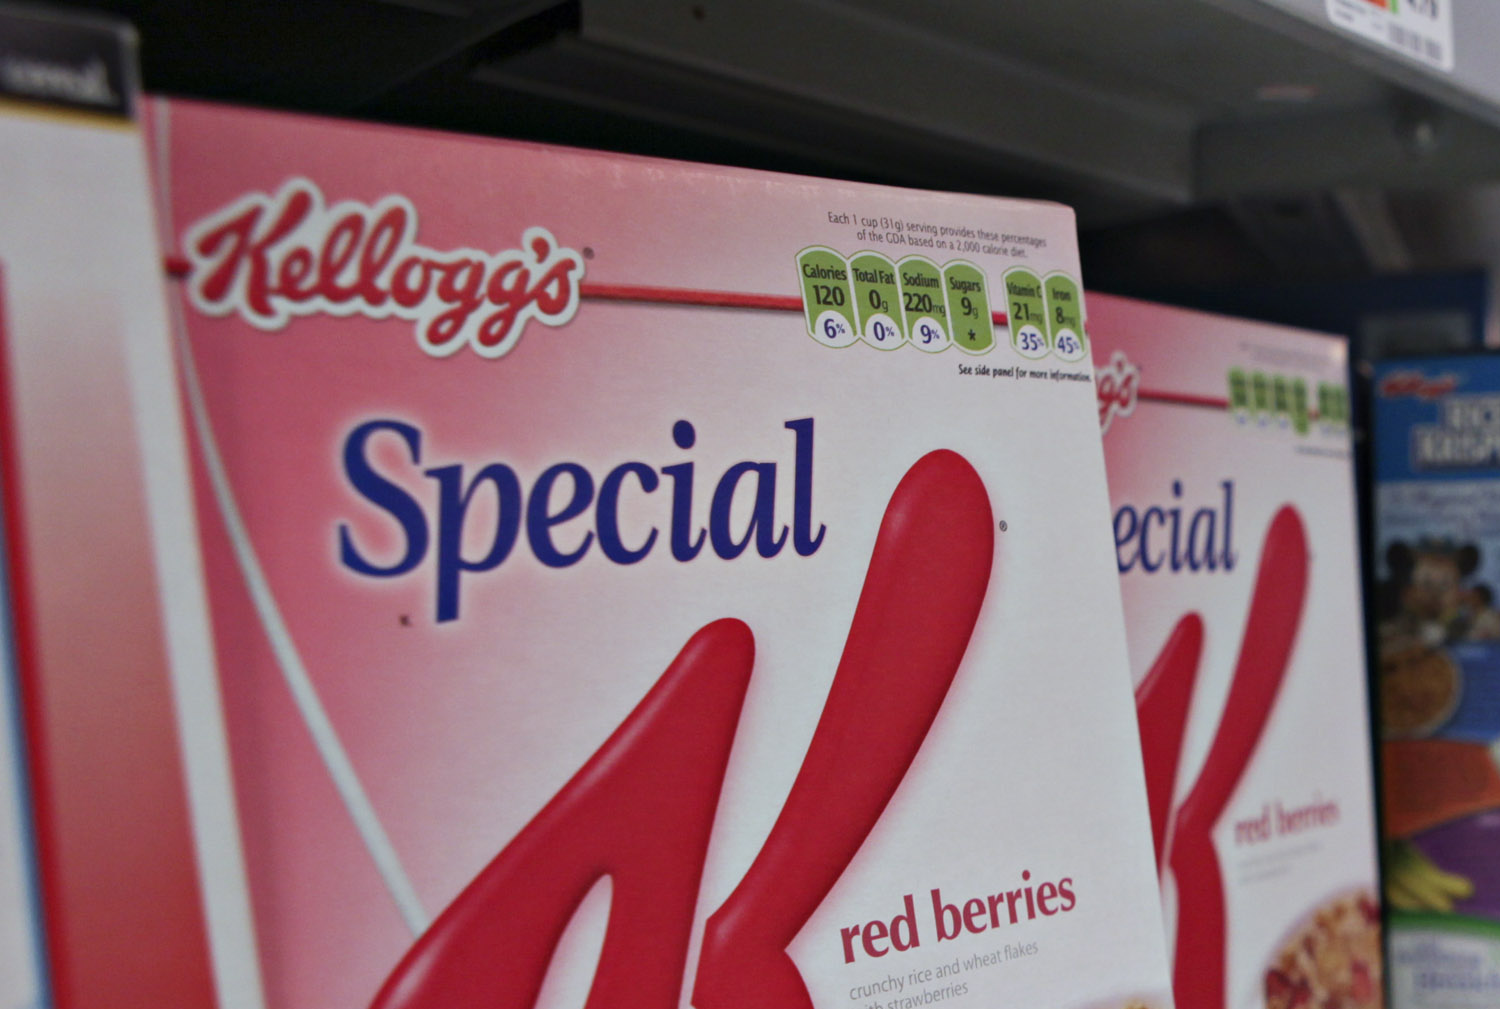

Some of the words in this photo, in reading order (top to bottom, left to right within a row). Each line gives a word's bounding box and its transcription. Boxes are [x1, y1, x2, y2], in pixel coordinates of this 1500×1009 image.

[828, 212, 850, 224] Each
[853, 214, 858, 225] 1
[861, 217, 878, 228] cup
[880, 217, 904, 232] (31g)
[906, 222, 938, 236] serving
[940, 226, 976, 239] provides
[977, 229, 999, 241] these
[1001, 233, 1047, 249] percentages
[857, 230, 866, 240] of
[869, 231, 883, 242] the
[908, 236, 934, 248] based
[936, 240, 947, 249] on
[949, 242, 954, 250] a
[956, 240, 980, 253] 2,000
[982, 244, 1009, 257] calorie
[194, 188, 577, 348] Kellogg's
[803, 264, 848, 282] Calories
[853, 268, 879, 283] Total
[879, 271, 896, 286] Fat
[903, 272, 940, 289] Sodium
[950, 276, 982, 293] Sugars
[1006, 282, 1036, 297] Vitamin
[813, 285, 845, 307] 120
[869, 289, 889, 313] 0g
[904, 292, 946, 318] 220mg
[1052, 288, 1071, 302] Iron
[961, 296, 979, 320] 9g
[1012, 302, 1043, 325] 21mg
[824, 318, 846, 340] 6%
[873, 321, 895, 342] 0%
[920, 324, 940, 345] 9%
[958, 363, 974, 376] See
[974, 365, 991, 377] side
[992, 367, 1015, 379] panel
[1015, 366, 1028, 381] for
[1028, 370, 1048, 380] more
[338, 416, 828, 624] Special
[1113, 479, 1236, 574] ecial
[840, 893, 921, 964] red
[930, 869, 1077, 944] berries
[849, 974, 905, 1001] crunchy
[908, 968, 933, 986] rice
[935, 959, 961, 979] and
[962, 949, 1003, 973] wheat
[1003, 940, 1040, 962] flakes
